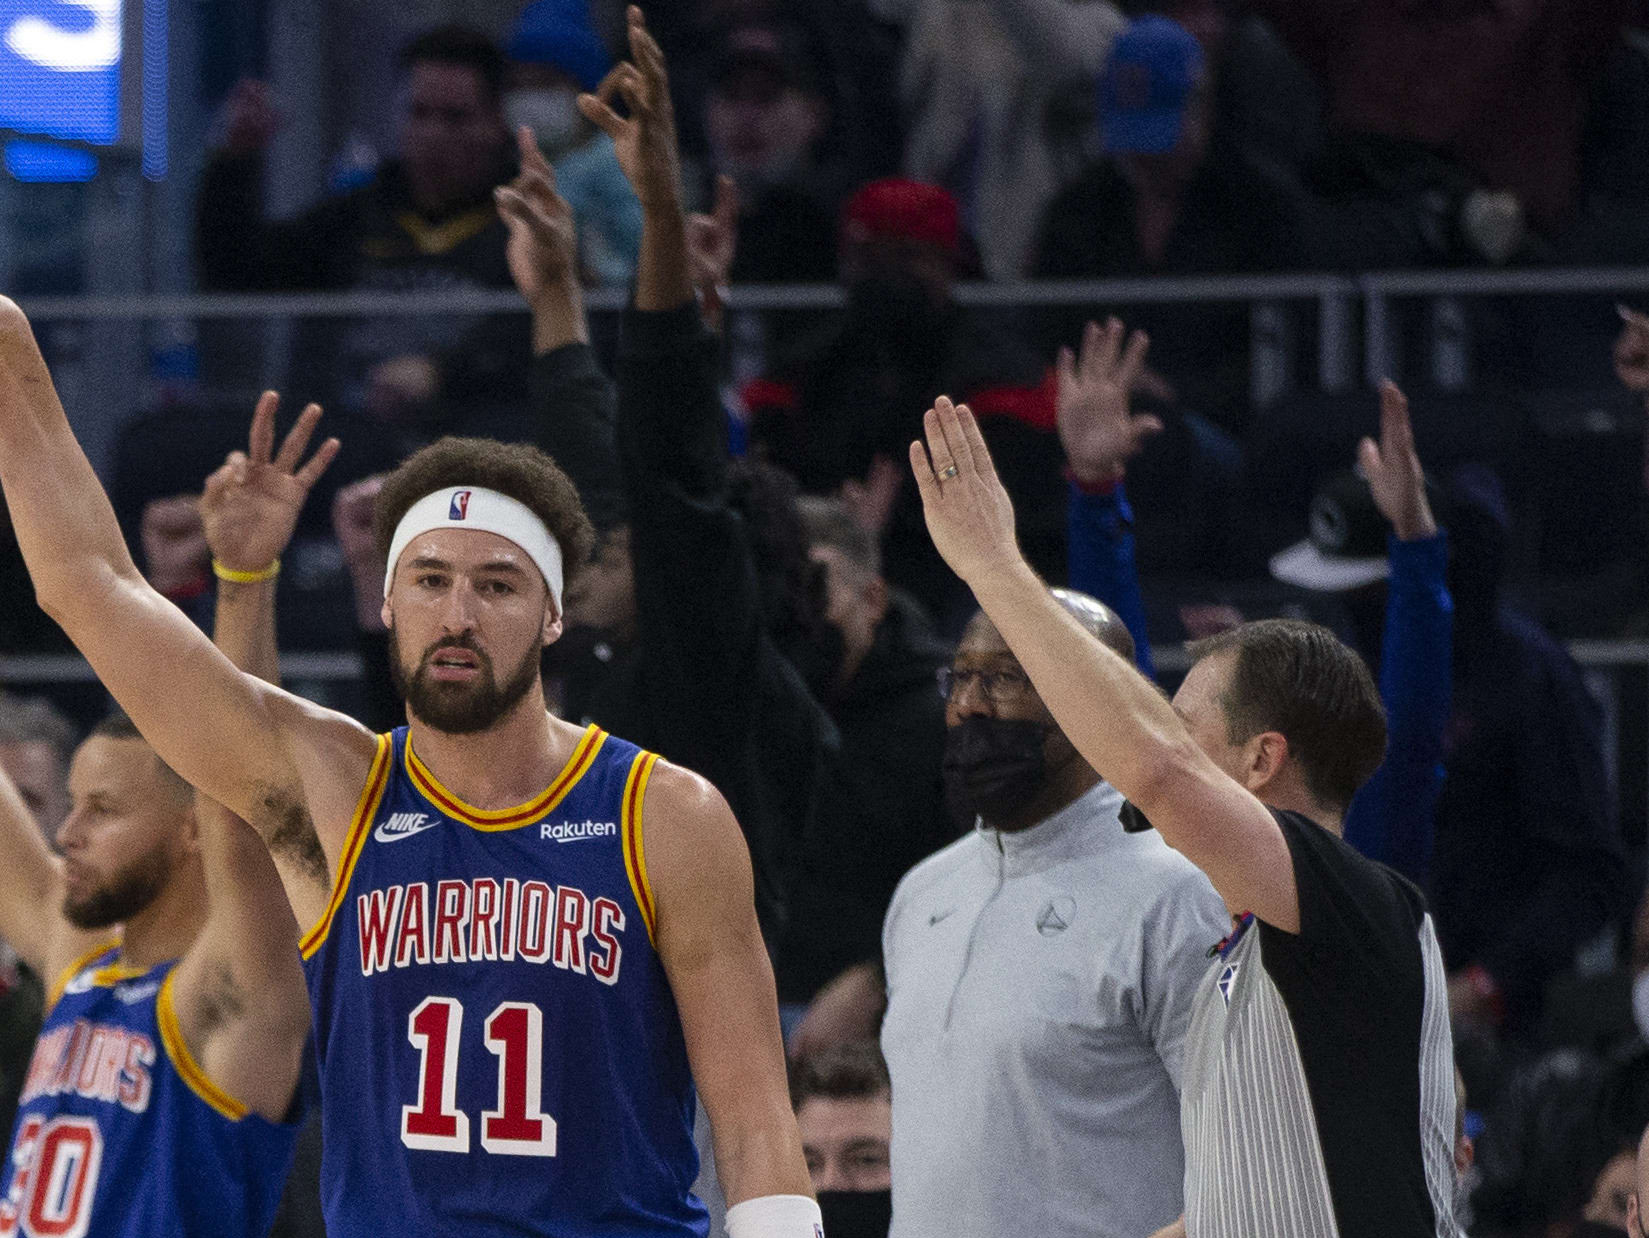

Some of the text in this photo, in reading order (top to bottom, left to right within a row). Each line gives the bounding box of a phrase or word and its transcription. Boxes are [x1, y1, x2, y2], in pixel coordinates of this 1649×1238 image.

[384, 812, 429, 833] NIKE
[540, 820, 617, 840] Rakuten
[357, 877, 626, 986] WARRIORS
[400, 995, 557, 1157] 11
